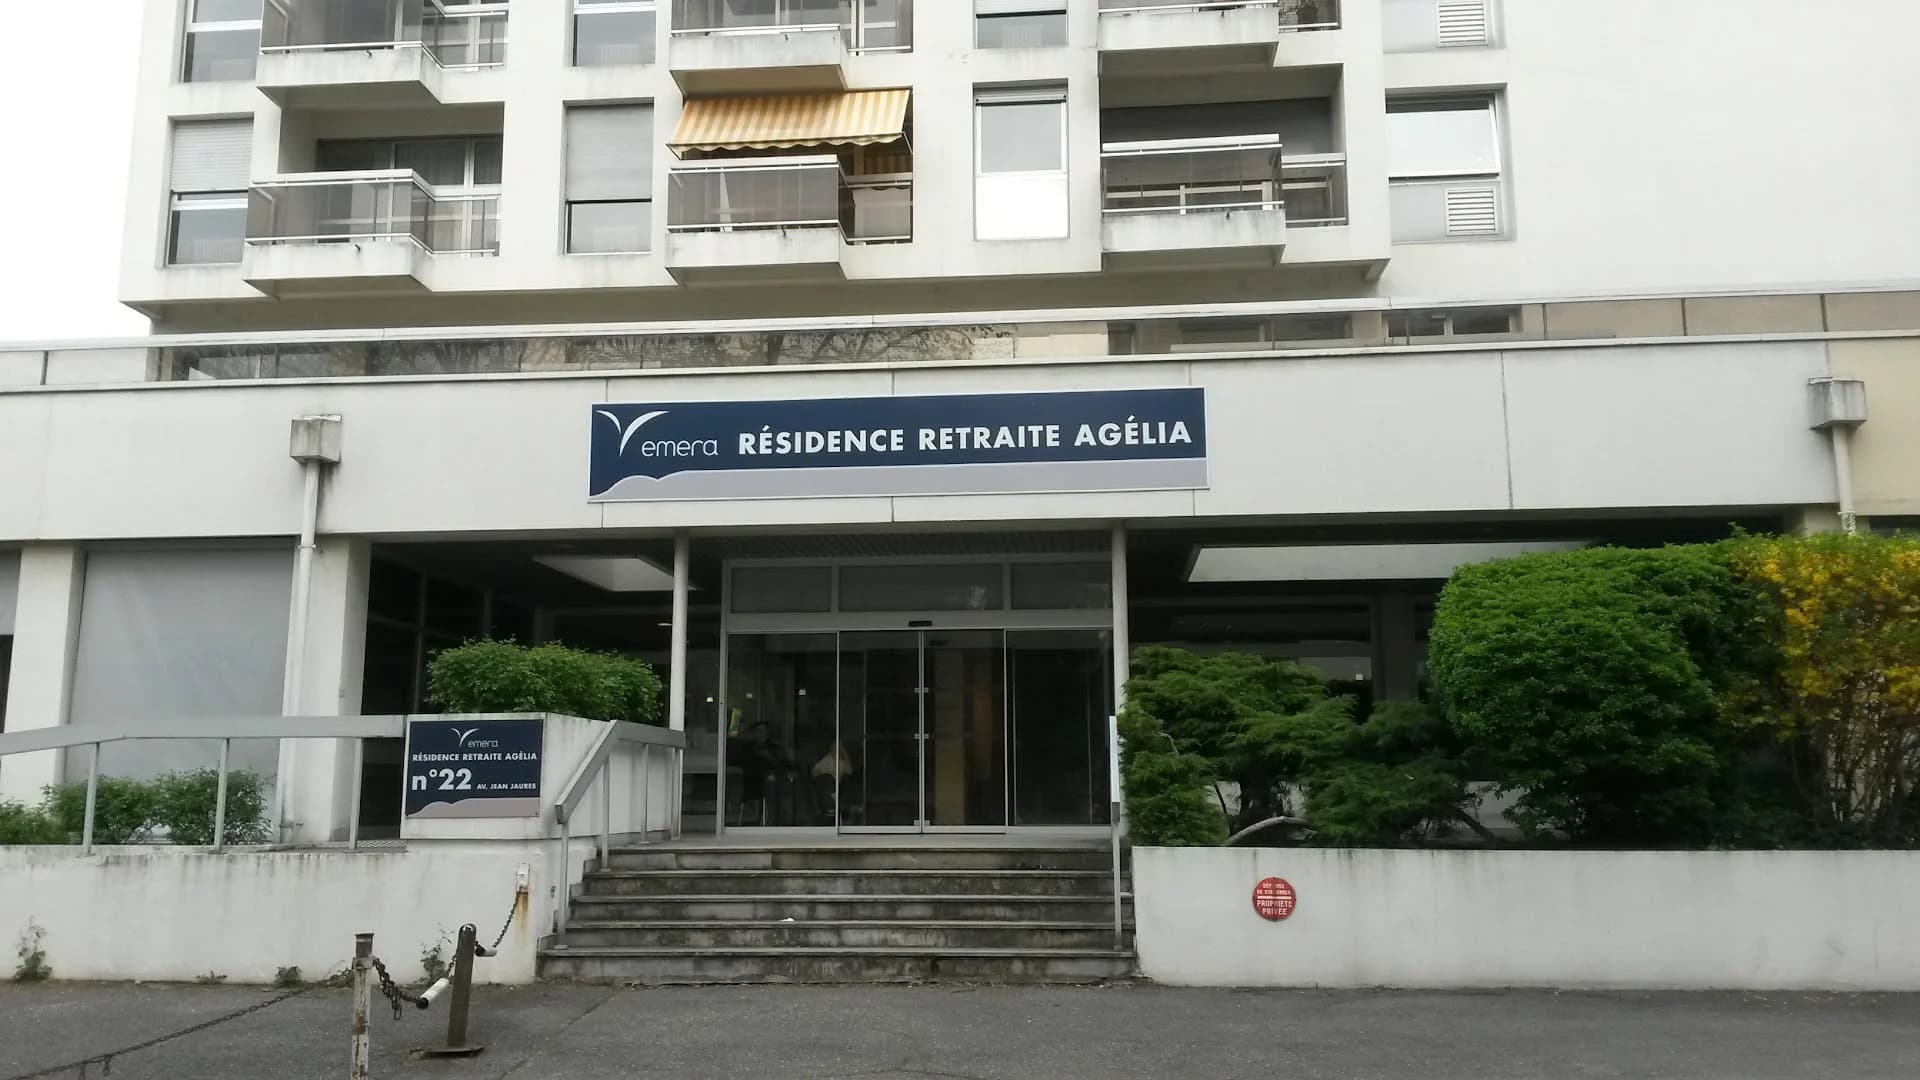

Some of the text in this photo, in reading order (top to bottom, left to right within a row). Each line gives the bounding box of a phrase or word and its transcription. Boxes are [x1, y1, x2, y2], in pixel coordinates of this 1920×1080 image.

[641, 414, 1192, 458] emera RÉSIDENCE RETRAITE AGÉLIA
[467, 740, 499, 748] emera
[412, 750, 538, 762] RÉSIDENCE RETRAITE AGÉLIA
